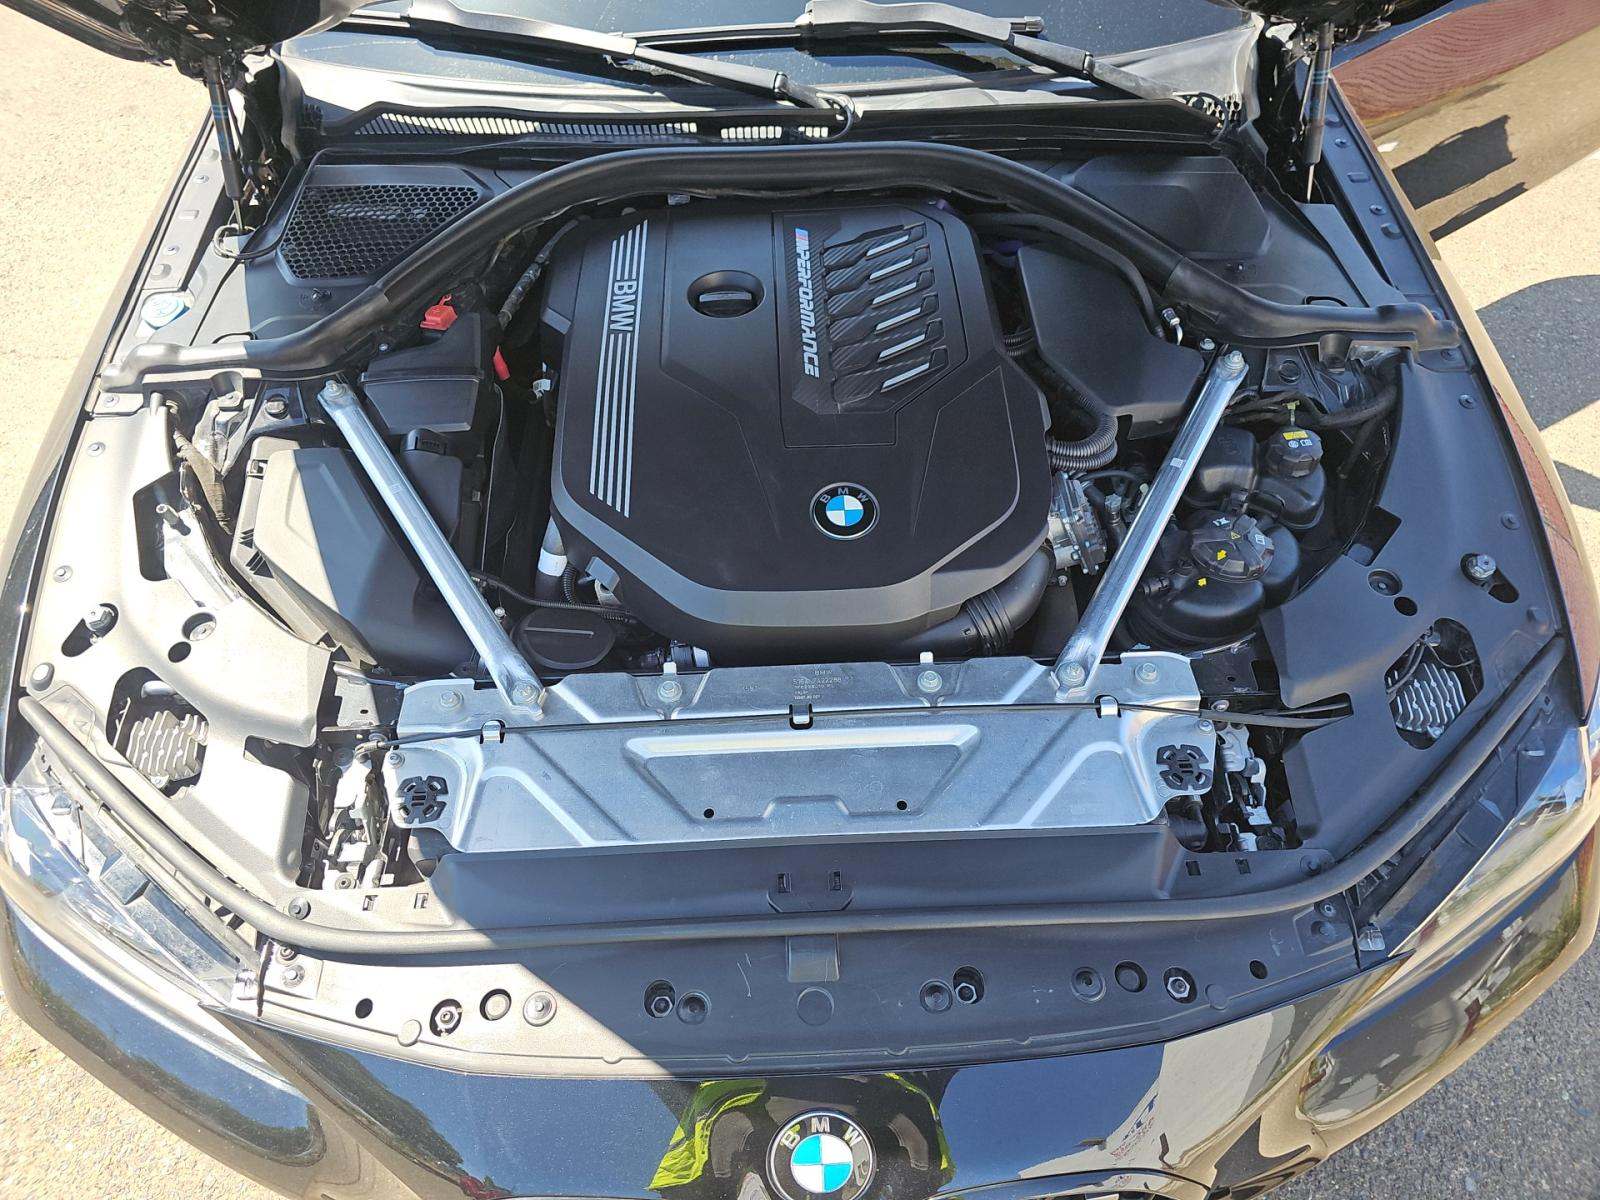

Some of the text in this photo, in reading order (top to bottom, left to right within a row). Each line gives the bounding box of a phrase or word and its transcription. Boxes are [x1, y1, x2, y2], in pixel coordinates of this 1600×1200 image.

[609, 281, 637, 331] BMW
[820, 487, 869, 503] BMW
[780, 1116, 863, 1150] BMW
